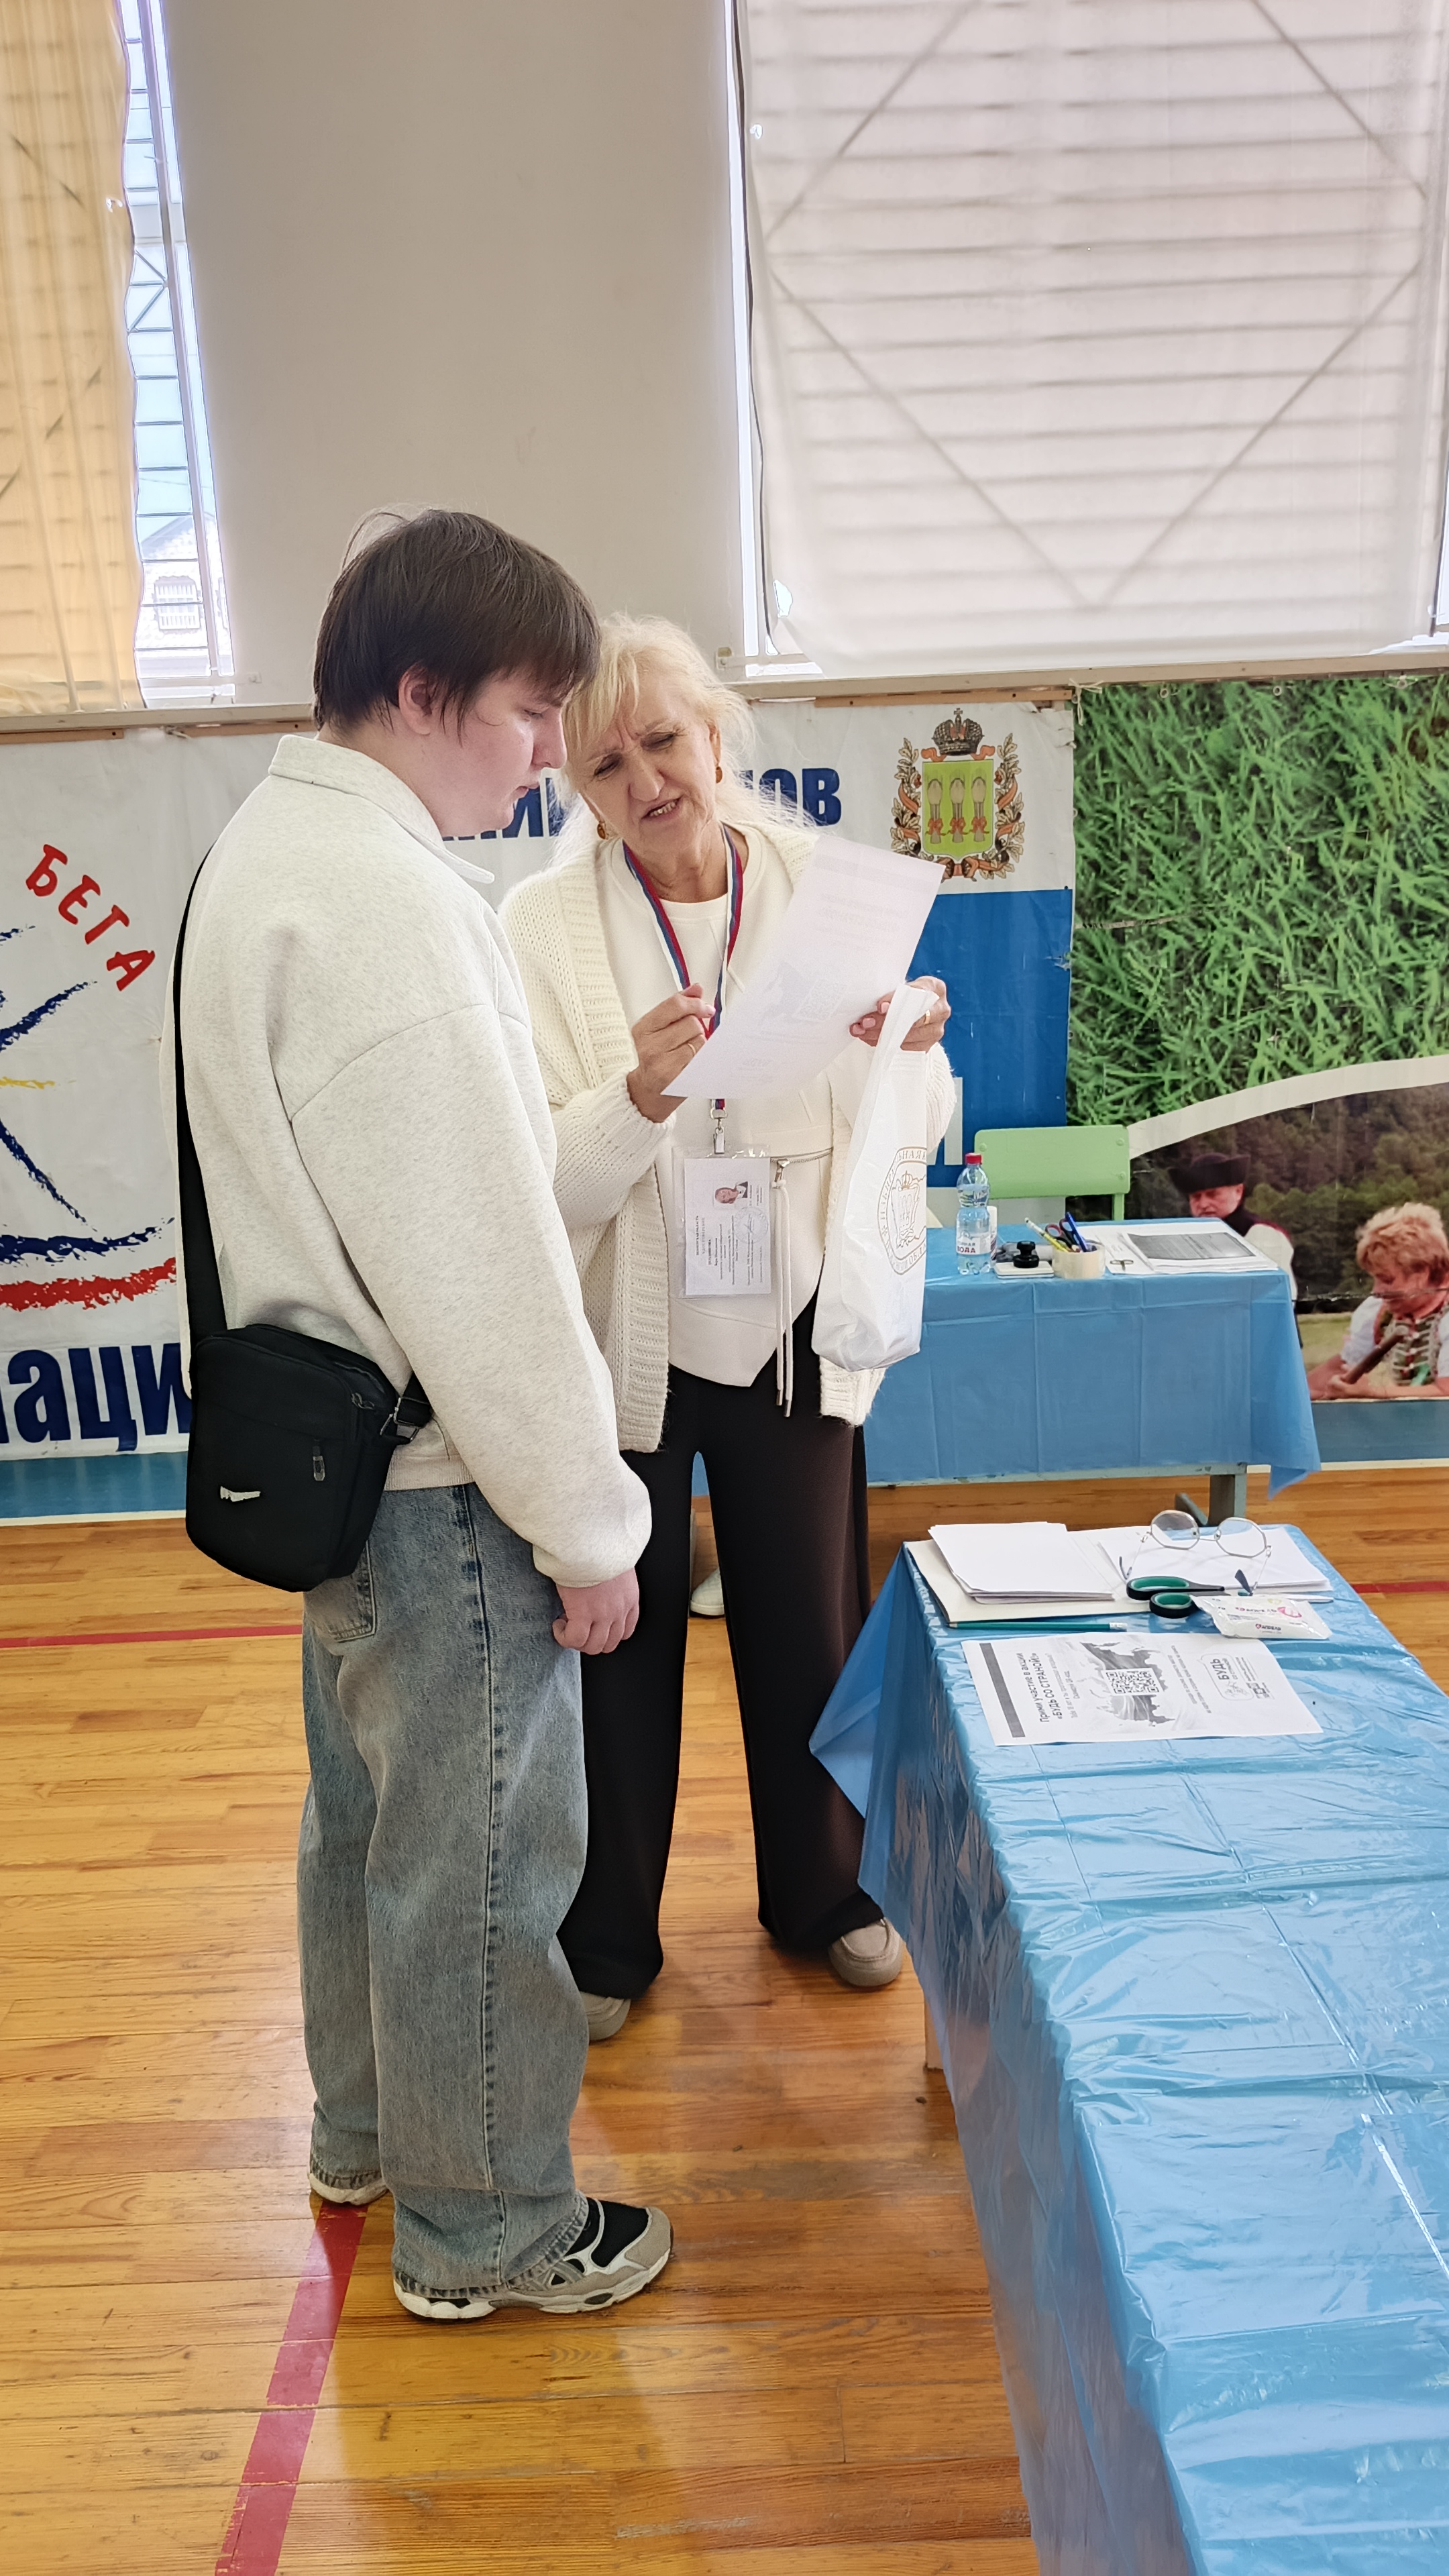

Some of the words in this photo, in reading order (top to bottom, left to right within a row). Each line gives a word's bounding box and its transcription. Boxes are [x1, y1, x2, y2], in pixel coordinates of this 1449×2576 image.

[26, 844, 155, 991] БЕГА
[1016, 1653, 1029, 1670] акции
[1210, 1658, 1230, 1680] БУДЬ
[1025, 1676, 1043, 1702] участие
[1042, 1688, 1055, 1699] СО
[1035, 1702, 1050, 1723] Прими
